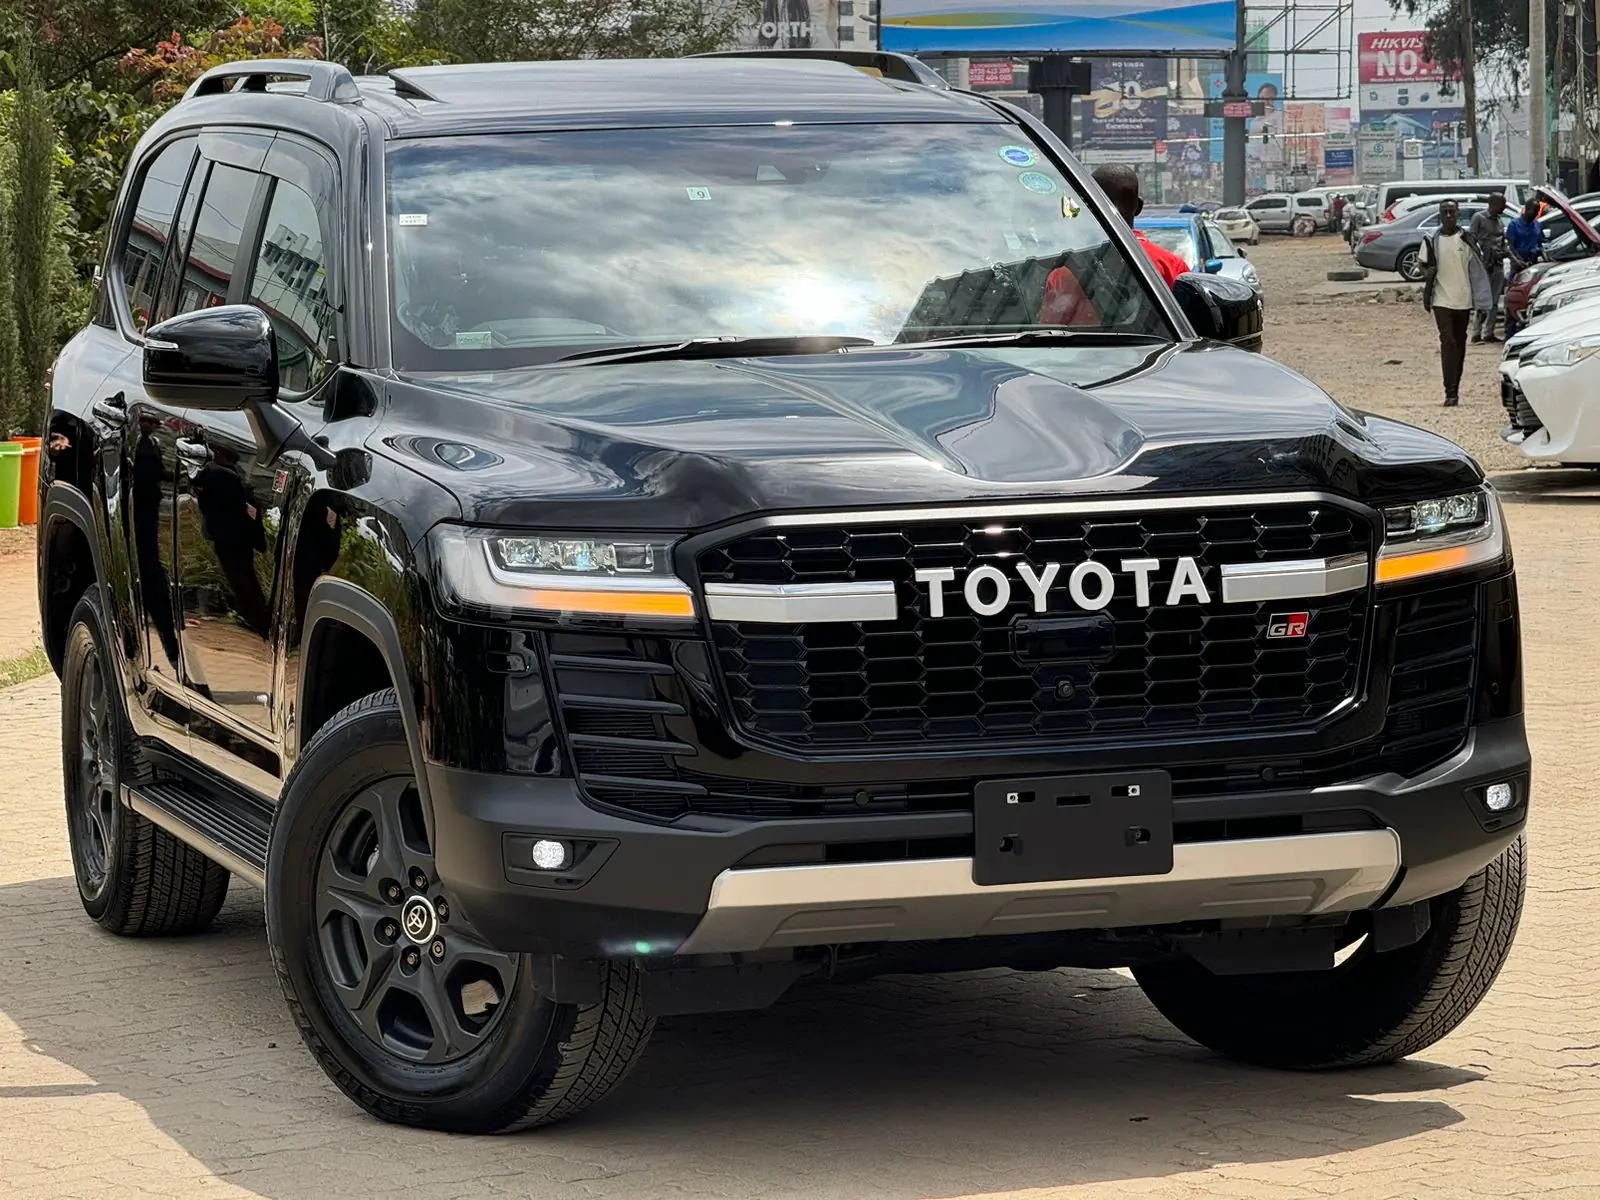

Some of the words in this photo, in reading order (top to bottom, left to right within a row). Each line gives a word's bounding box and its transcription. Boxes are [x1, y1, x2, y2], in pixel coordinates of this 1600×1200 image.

[1370, 37, 1424, 49] HIKVIS
[914, 556, 1211, 618] TOYOTA
[1269, 622, 1305, 636] GR
